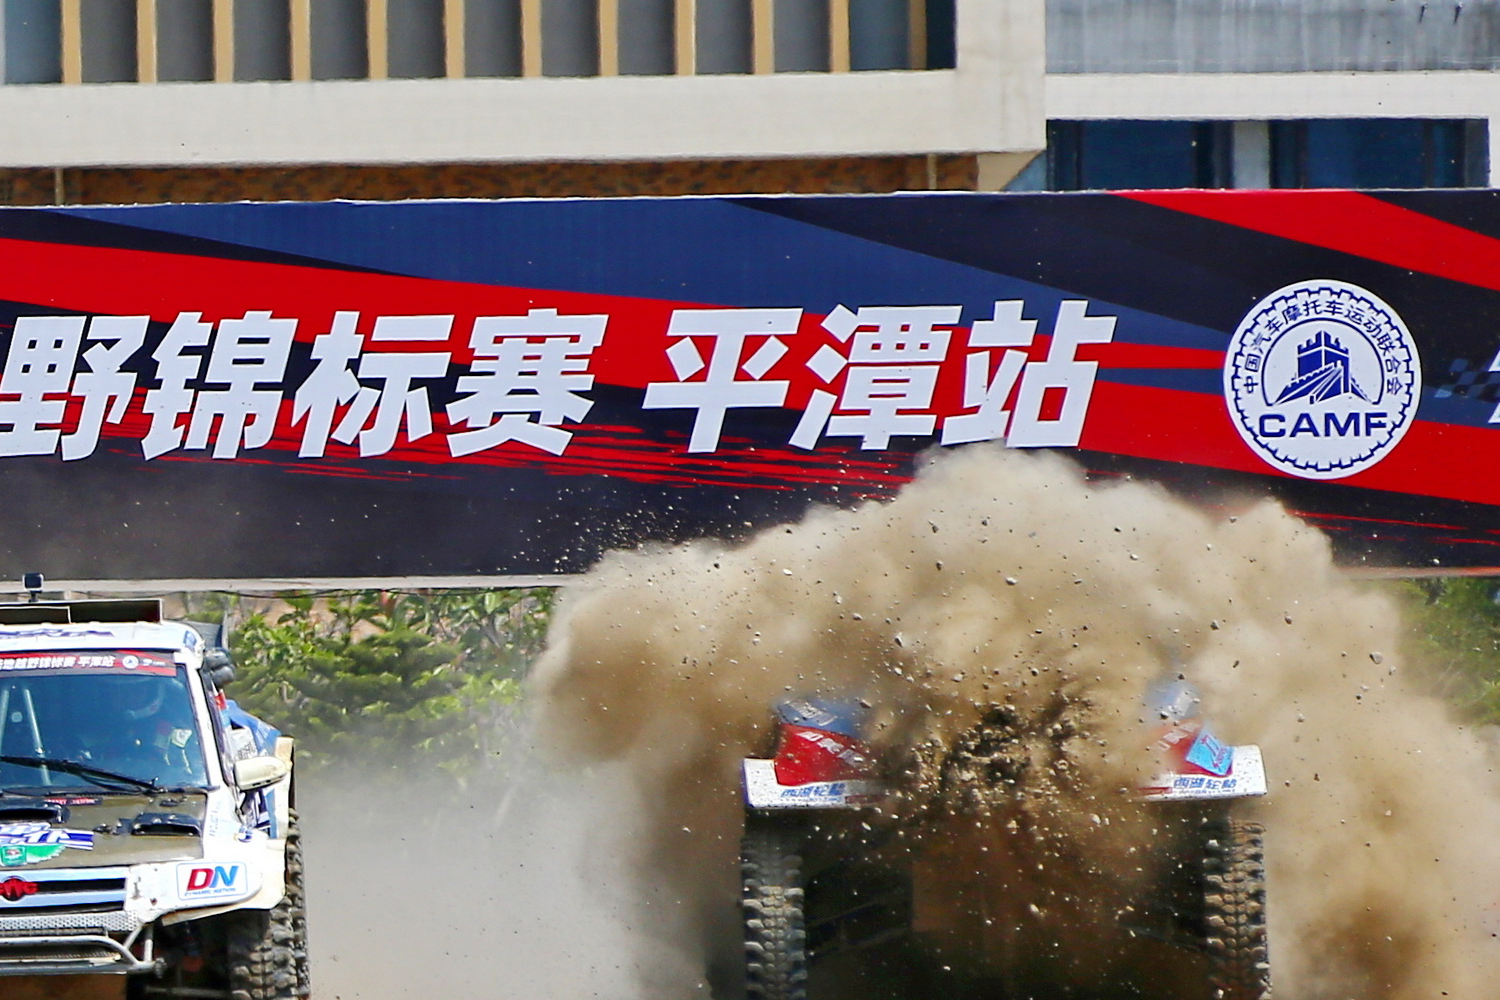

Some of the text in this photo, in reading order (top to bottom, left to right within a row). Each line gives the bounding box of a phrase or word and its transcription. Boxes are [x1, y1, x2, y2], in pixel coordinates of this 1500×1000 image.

[642, 298, 1118, 454] 平潭站
[1243, 299, 1403, 396] 中国汽车摩托车运动联合会
[1258, 411, 1388, 438] CAMF
[186, 866, 239, 891] DN
